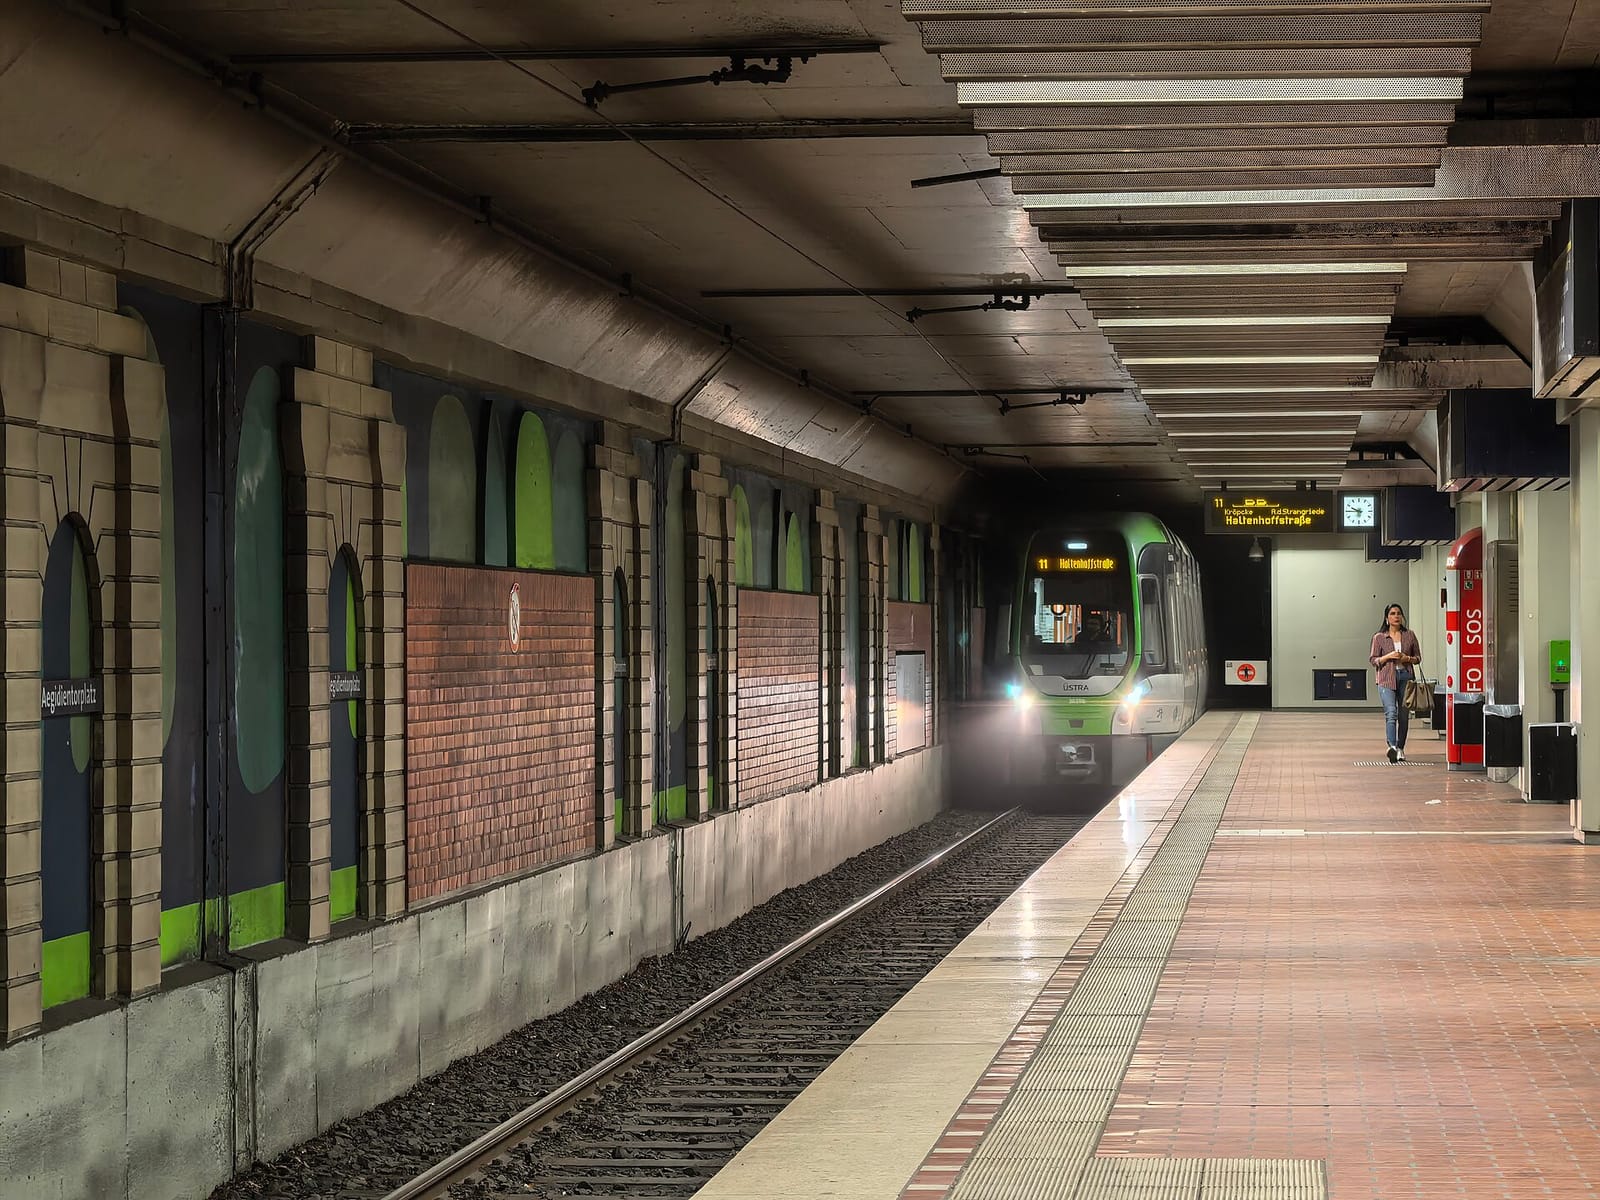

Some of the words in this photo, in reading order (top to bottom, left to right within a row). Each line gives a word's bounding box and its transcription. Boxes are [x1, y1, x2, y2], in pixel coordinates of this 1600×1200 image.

[1214, 498, 1223, 508] 11
[1224, 508, 1254, 516] Kröpcke
[1226, 515, 1312, 527] Haltenhoffstraße
[1039, 558, 1048, 569] 11
[1466, 608, 1482, 644] SOS
[1466, 668, 1482, 692] FO
[41, 682, 97, 714] Aegidientorplatz
